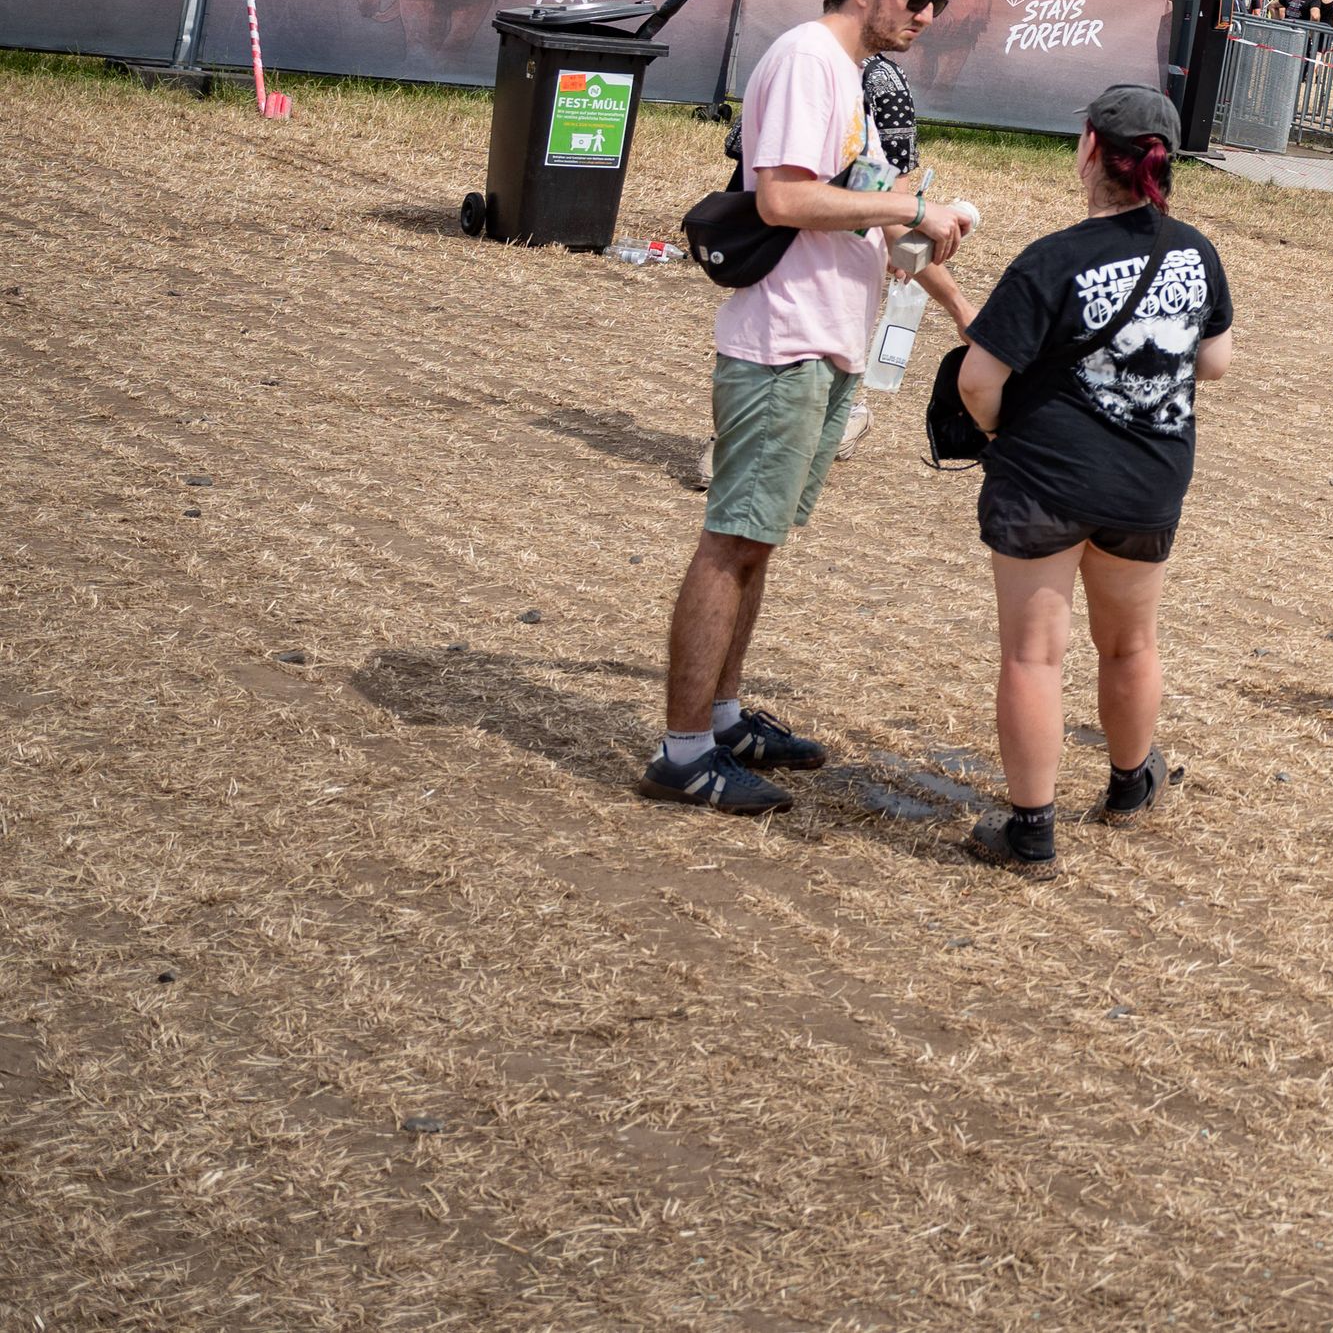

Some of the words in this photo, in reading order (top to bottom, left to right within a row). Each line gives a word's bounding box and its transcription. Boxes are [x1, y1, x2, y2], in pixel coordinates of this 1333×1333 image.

[1004, 19, 1104, 55] FOREVER
[558, 97, 626, 111] FEST-MÜLL
[1075, 248, 1202, 289] WITNSS
[1133, 263, 1206, 287] EATH
